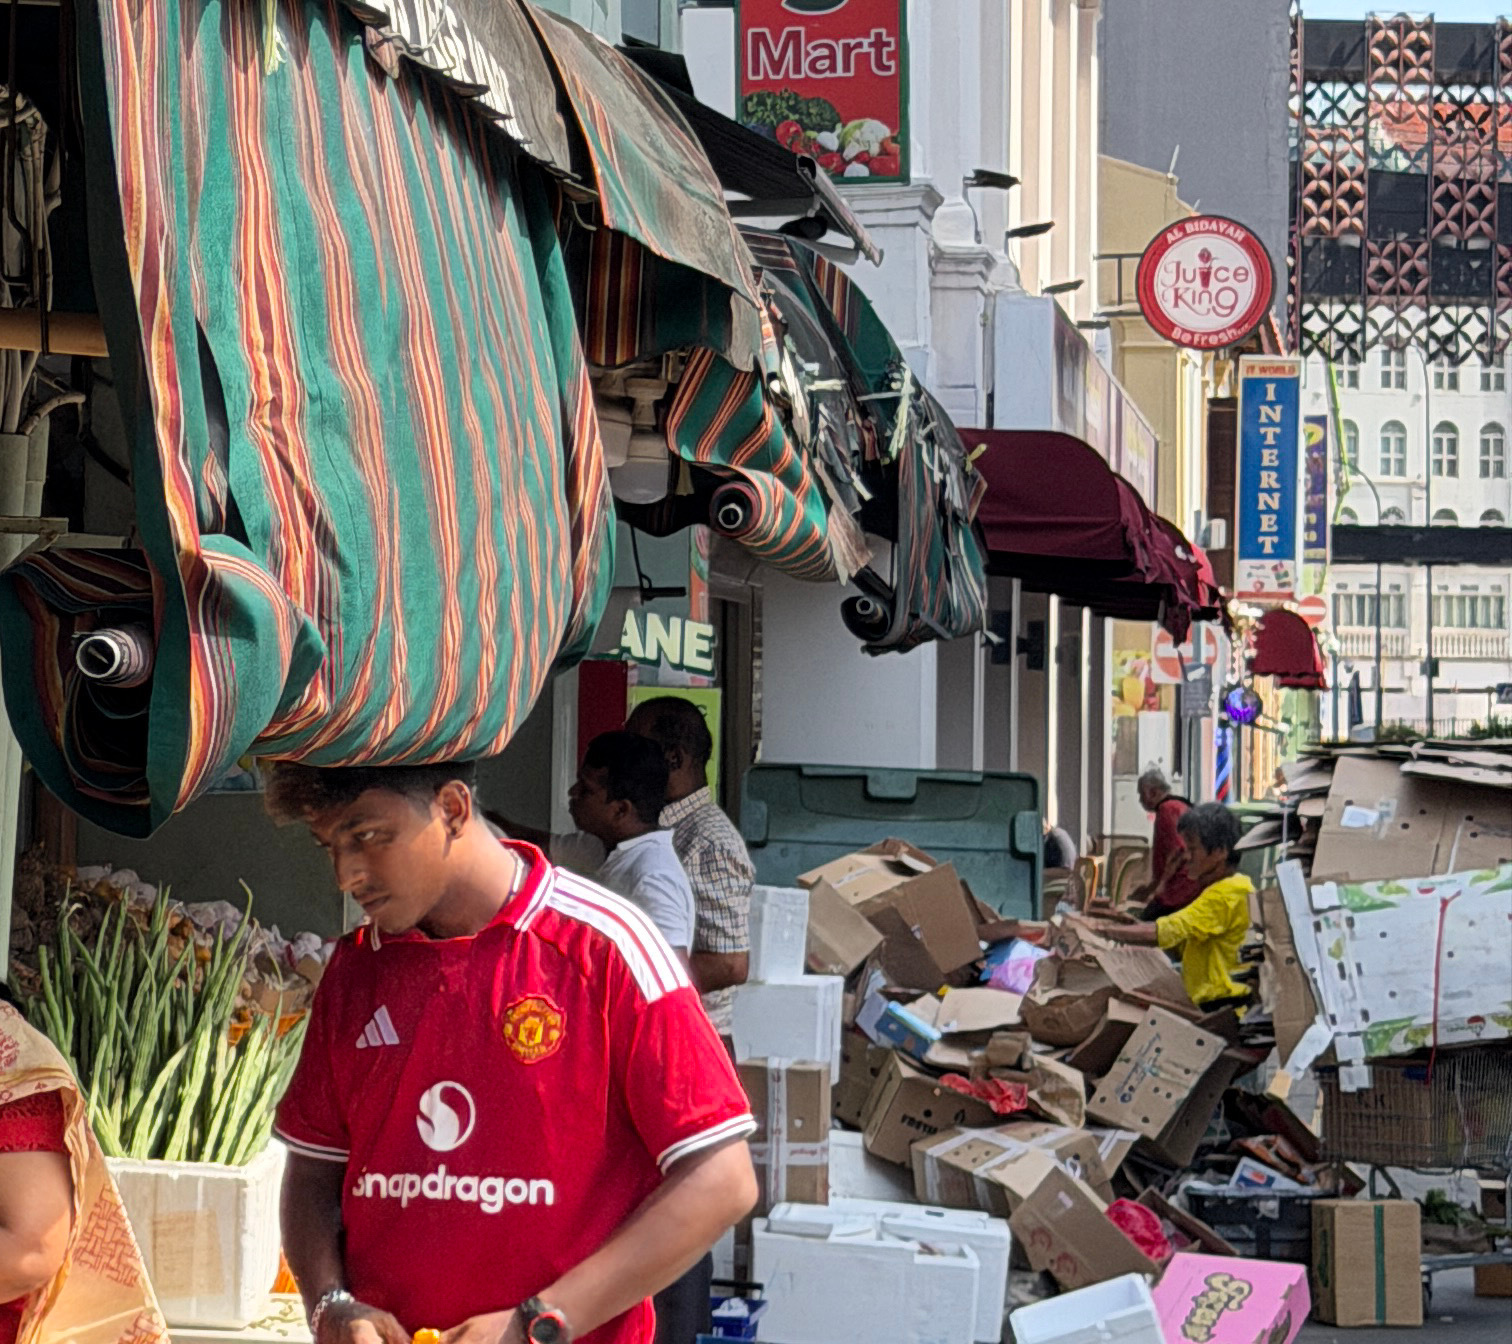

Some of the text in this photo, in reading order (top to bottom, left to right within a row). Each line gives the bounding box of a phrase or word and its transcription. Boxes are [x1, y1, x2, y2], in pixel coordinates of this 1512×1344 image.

[747, 25, 896, 81] Mart
[1166, 220, 1246, 244] AL BIDAYAH
[1162, 286, 1239, 318] King
[1257, 383, 1283, 555] INTERNET
[610, 609, 714, 672] ANE
